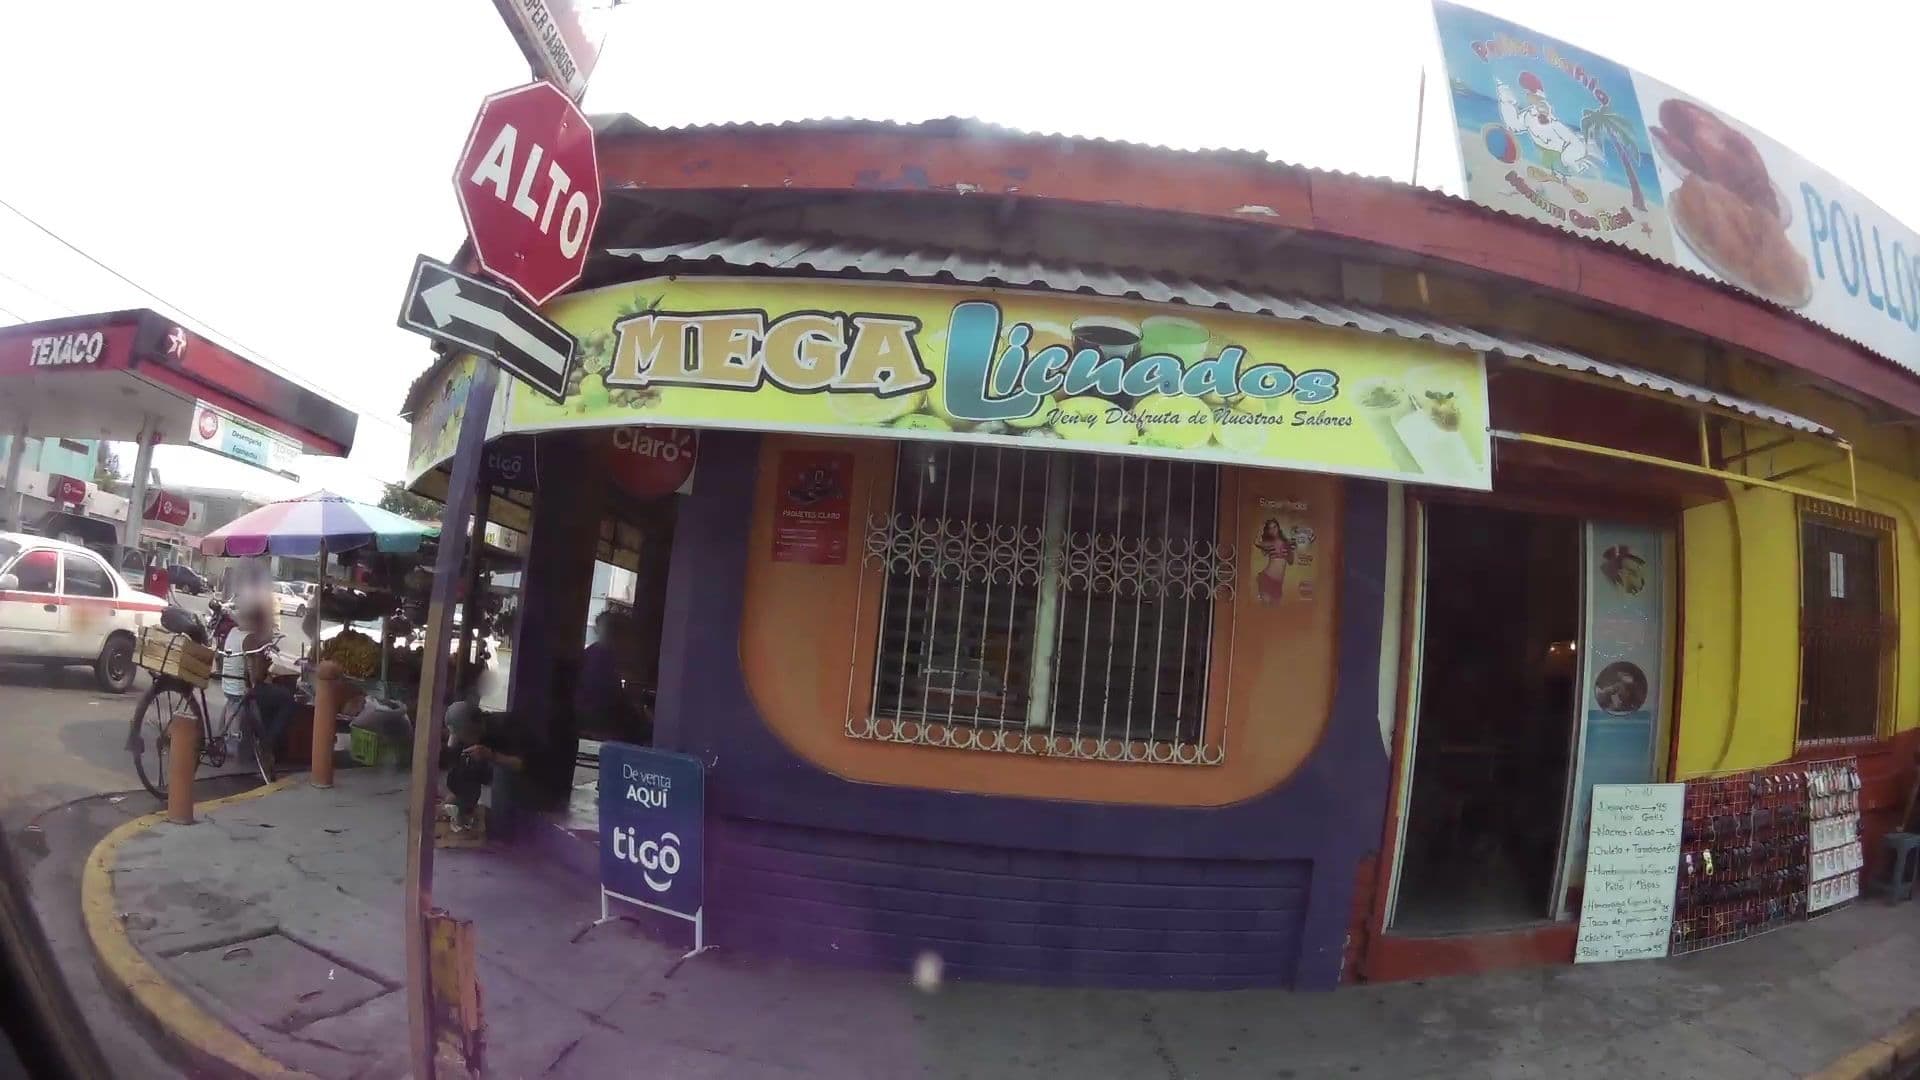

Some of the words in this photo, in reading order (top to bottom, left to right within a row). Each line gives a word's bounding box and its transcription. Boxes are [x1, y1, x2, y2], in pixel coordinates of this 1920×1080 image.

[543, 23, 576, 82] SABROSO
[470, 123, 589, 260] ALTO
[29, 330, 104, 366] TEXACO
[604, 309, 936, 399] MEGA
[943, 300, 1339, 422] Licuados
[1046, 408, 1081, 427] Ven
[1105, 408, 1181, 427] Disfruta
[1187, 408, 1208, 426] de
[1212, 408, 1284, 427] Nuestros
[1290, 410, 1353, 427] Sabores
[612, 426, 680, 461] Claro
[488, 455, 522, 474] tigo
[623, 764, 639, 780] De
[640, 771, 672, 789] venta
[613, 827, 681, 875] tigo
